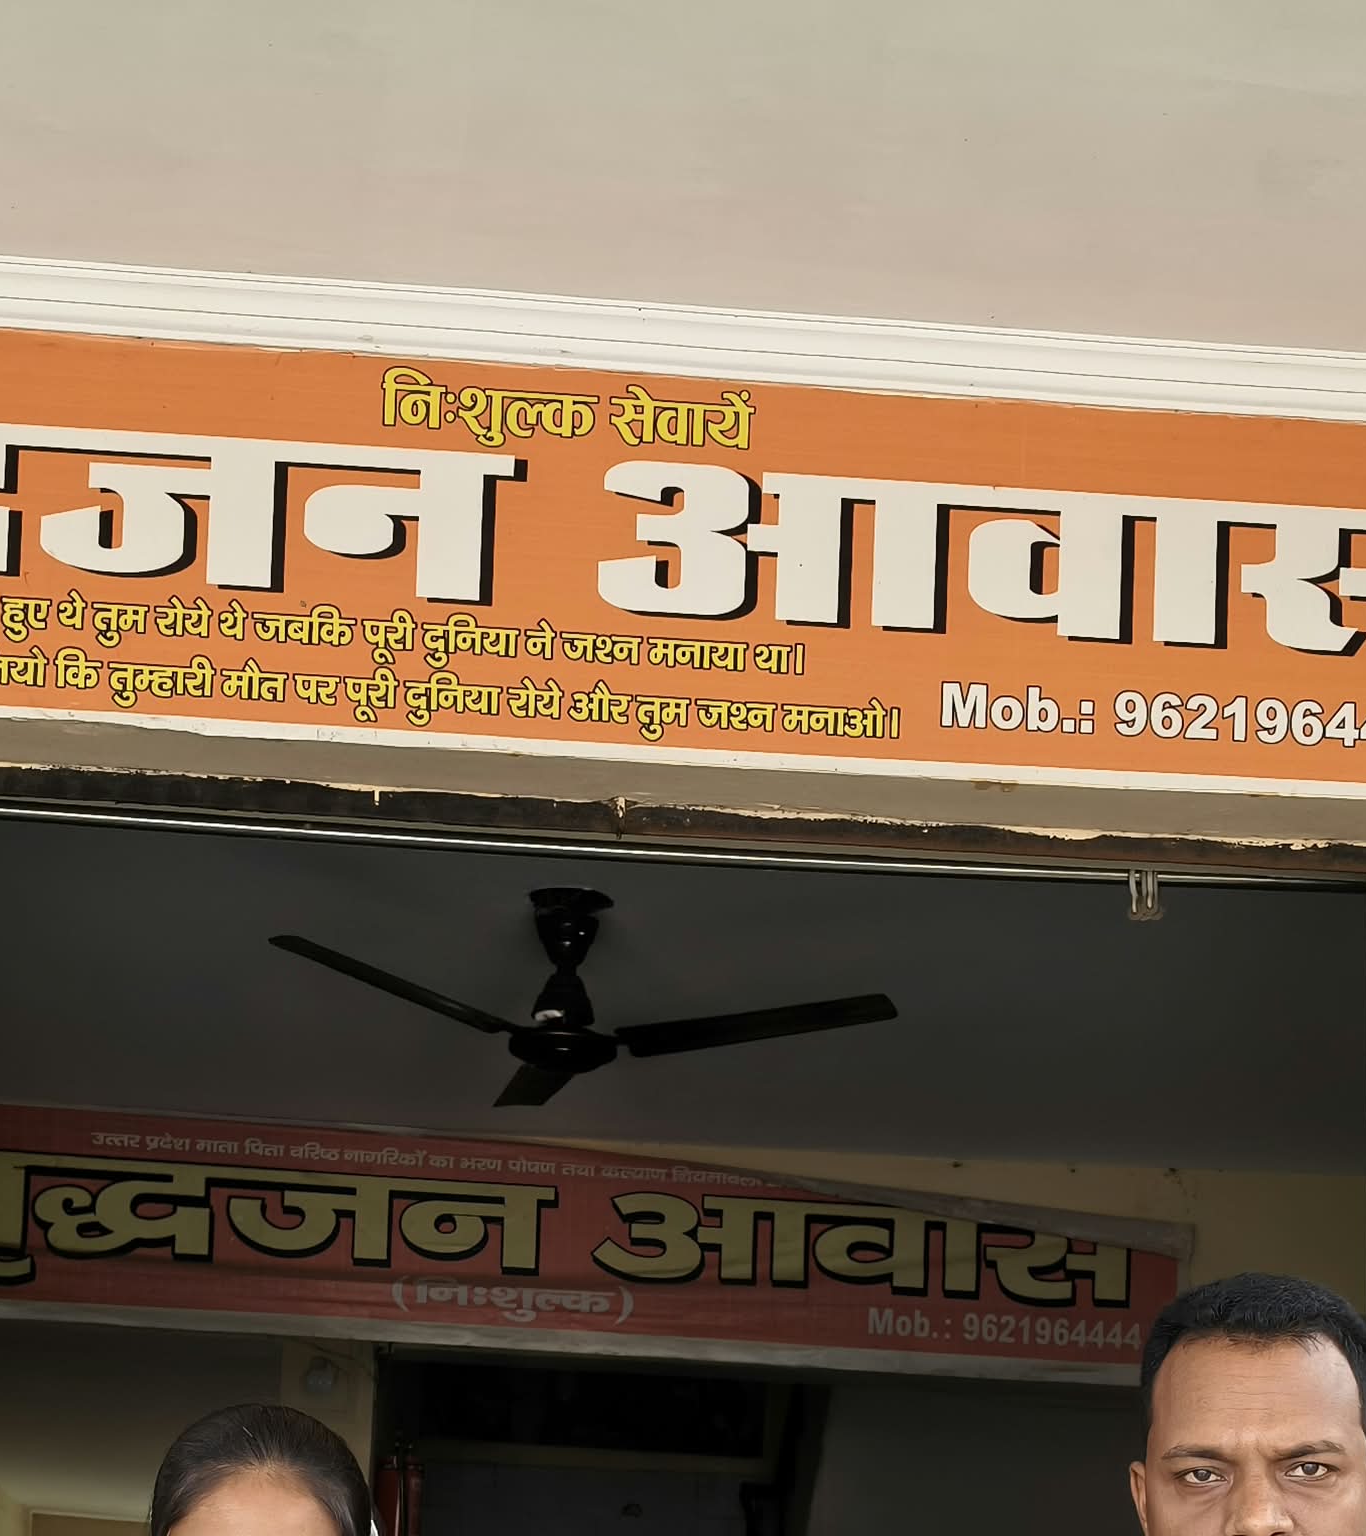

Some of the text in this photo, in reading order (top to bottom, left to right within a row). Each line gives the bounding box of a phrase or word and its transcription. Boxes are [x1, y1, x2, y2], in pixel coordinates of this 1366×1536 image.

[610, 384, 756, 449] सेवायें
[1, 596, 51, 642] हुए
[57, 589, 87, 630] थे
[93, 601, 148, 648] तुम
[155, 596, 212, 638] रोये
[219, 599, 247, 640] थे
[252, 603, 356, 647] जबकि
[363, 608, 415, 664] पूरी
[422, 610, 518, 668] दुनिया
[525, 619, 558, 660] ने
[560, 632, 641, 665] जश्न
[647, 636, 748, 673] मनाया
[753, 644, 805, 676] था।
[55, 647, 102, 690] कि
[108, 654, 215, 708] तुम्हारी
[221, 657, 287, 702] मौत
[294, 671, 340, 705] पर
[344, 666, 398, 722] पूरी
[404, 669, 501, 727] दुनिया
[507, 676, 563, 720] रोये
[569, 680, 632, 724] और
[636, 695, 690, 742] तुम
[695, 698, 777, 732] जश्न
[781, 697, 900, 739] मनाओ।
[939, 681, 1095, 736] Mob.:
[91, 1131, 764, 1188] उत्तर प्रदेश माता पिता वरिष्ठ नागरिकों का भरण पोषण तथा कल्याण नियमावल
[591, 1191, 1131, 1308] आवास
[963, 1312, 1142, 1351] 9621964444
